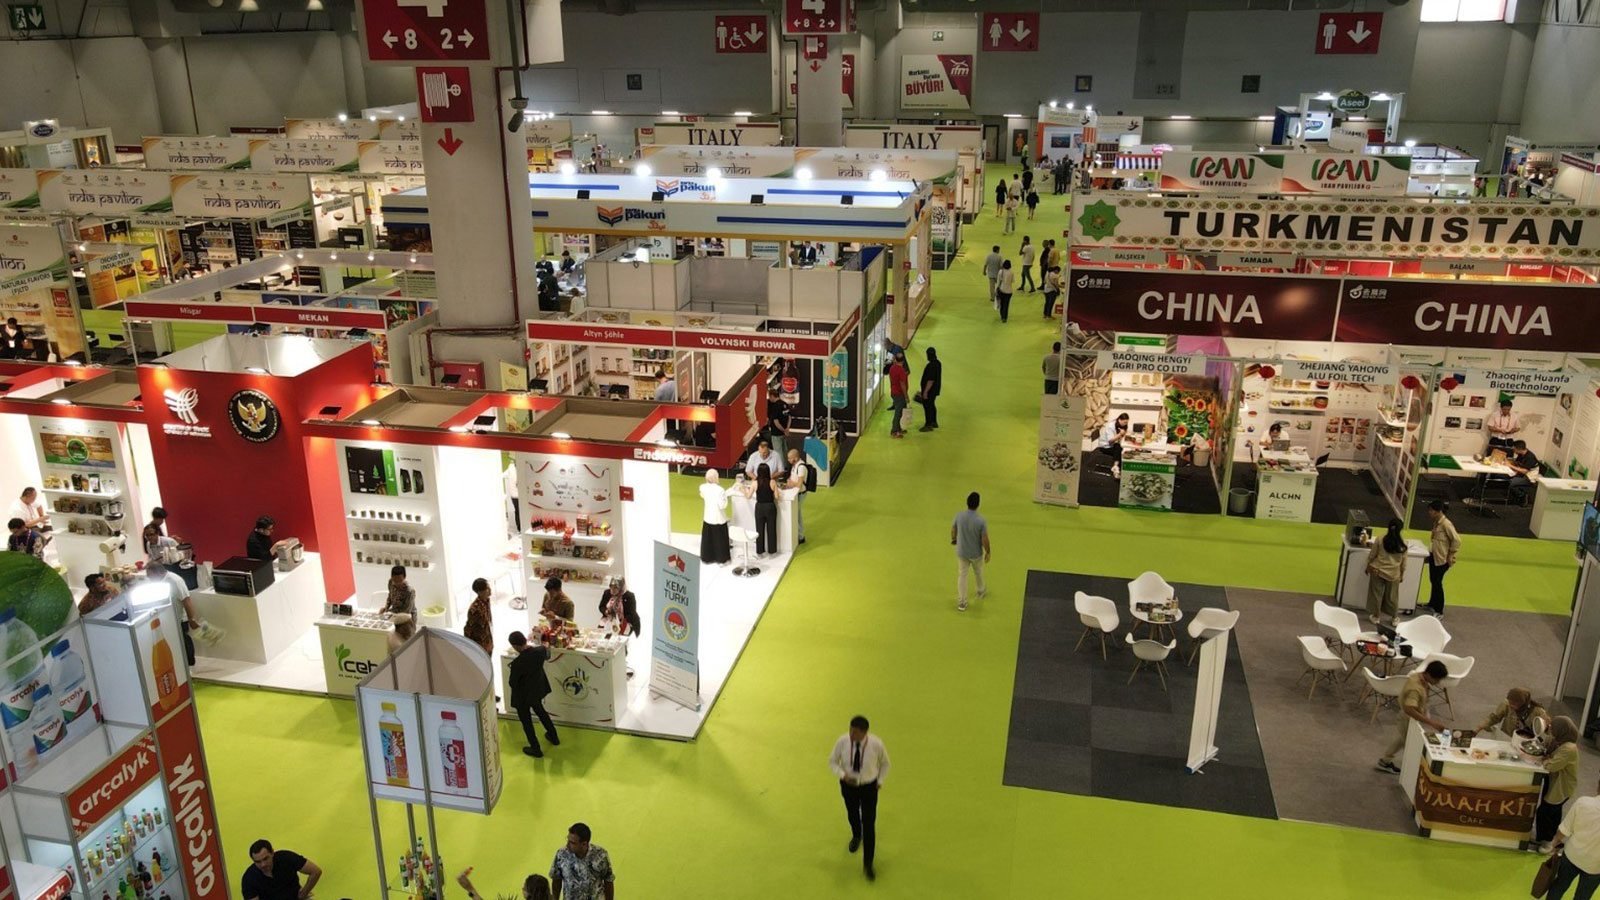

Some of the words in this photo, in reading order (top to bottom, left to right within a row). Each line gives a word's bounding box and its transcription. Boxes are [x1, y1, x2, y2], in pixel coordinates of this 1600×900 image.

[803, 18, 810, 28] 8
[819, 18, 825, 28] 2
[404, 28, 418, 50] 8
[440, 28, 454, 50] 2
[905, 79, 944, 96] BÜYÜR!
[688, 128, 743, 146] ITALY
[882, 132, 942, 150] ITALY
[168, 152, 190, 163] india
[192, 152, 227, 166] pavilion
[274, 154, 295, 166] india
[298, 154, 336, 168] pavilion
[384, 156, 407, 168] india
[838, 165, 864, 178] india
[1190, 156, 1256, 180] IRAN
[1312, 158, 1380, 182] IRAN
[68, 188, 96, 203] india
[98, 190, 143, 207] pavilion
[204, 193, 231, 209] india
[234, 195, 281, 212] pavilion
[1163, 211, 1583, 246] TURKMENISTAN
[1239, 256, 1273, 264] TAMADA
[1138, 290, 1263, 324] CHINA
[298, 314, 329, 322] MEKAN
[1414, 301, 1552, 336] CHINA
[584, 329, 602, 340] Altyn
[700, 336, 750, 348] VOLYNSKI
[752, 339, 796, 350] BROWAR
[1112, 353, 1155, 363] BAOQING
[1158, 354, 1192, 364] HENGYI
[1112, 362, 1134, 370] AGRI
[1136, 364, 1155, 372] PRO
[1157, 364, 1170, 372] CO
[1172, 365, 1188, 373] LTD
[1300, 362, 1345, 372] ZHEJIANG
[1348, 364, 1389, 374] YAHONG
[1307, 372, 1326, 380] ALU
[1328, 373, 1348, 382] FOIL
[1351, 374, 1376, 382] TECH
[1486, 371, 1532, 382] Zhaoqing
[1490, 380, 1561, 393] Biotechnology
[634, 448, 708, 466] Endonezya
[1269, 492, 1302, 500] ALCHN
[665, 579, 687, 595] KEMI
[664, 588, 689, 607] TURKI
[79, 752, 150, 816] arçalyk
[169, 753, 216, 897] arçalyk
